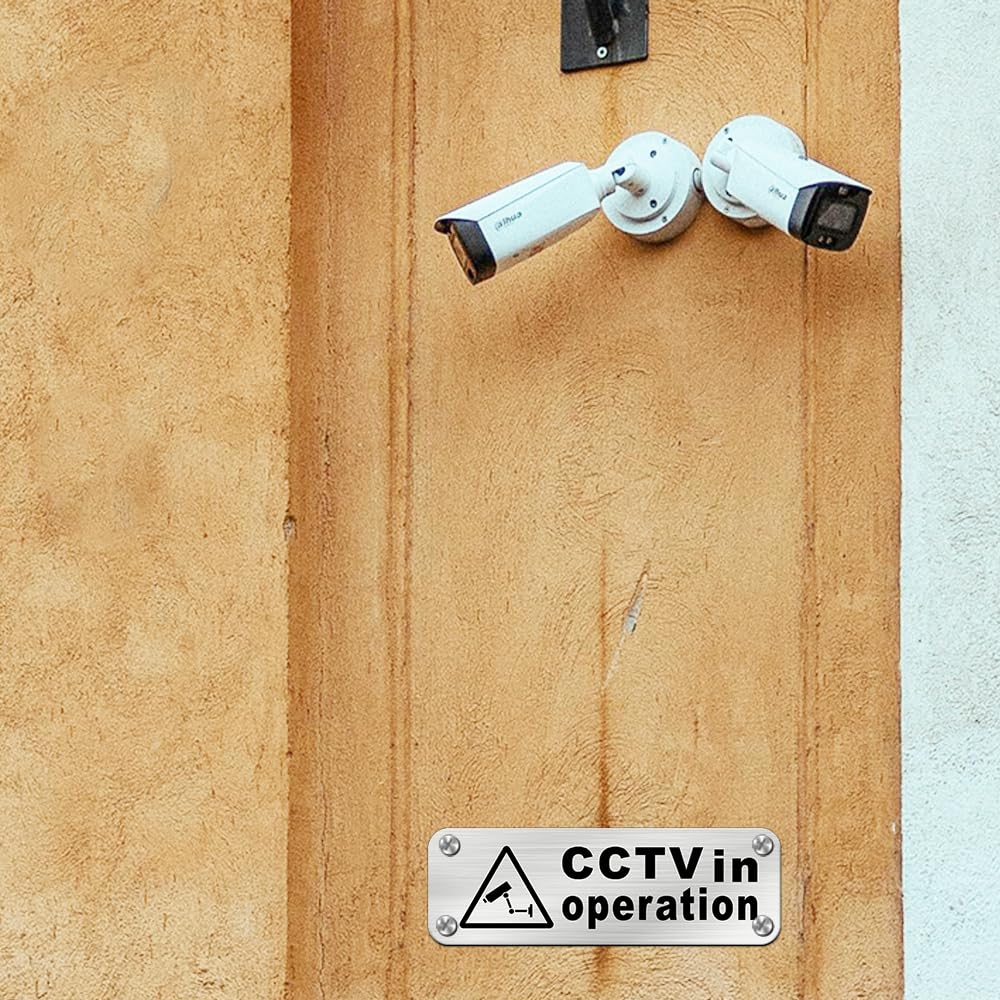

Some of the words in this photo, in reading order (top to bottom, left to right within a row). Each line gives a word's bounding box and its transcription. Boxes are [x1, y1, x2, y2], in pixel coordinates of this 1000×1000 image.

[562, 846, 704, 880] CCTV
[713, 849, 758, 882] in
[562, 887, 758, 930] operation
